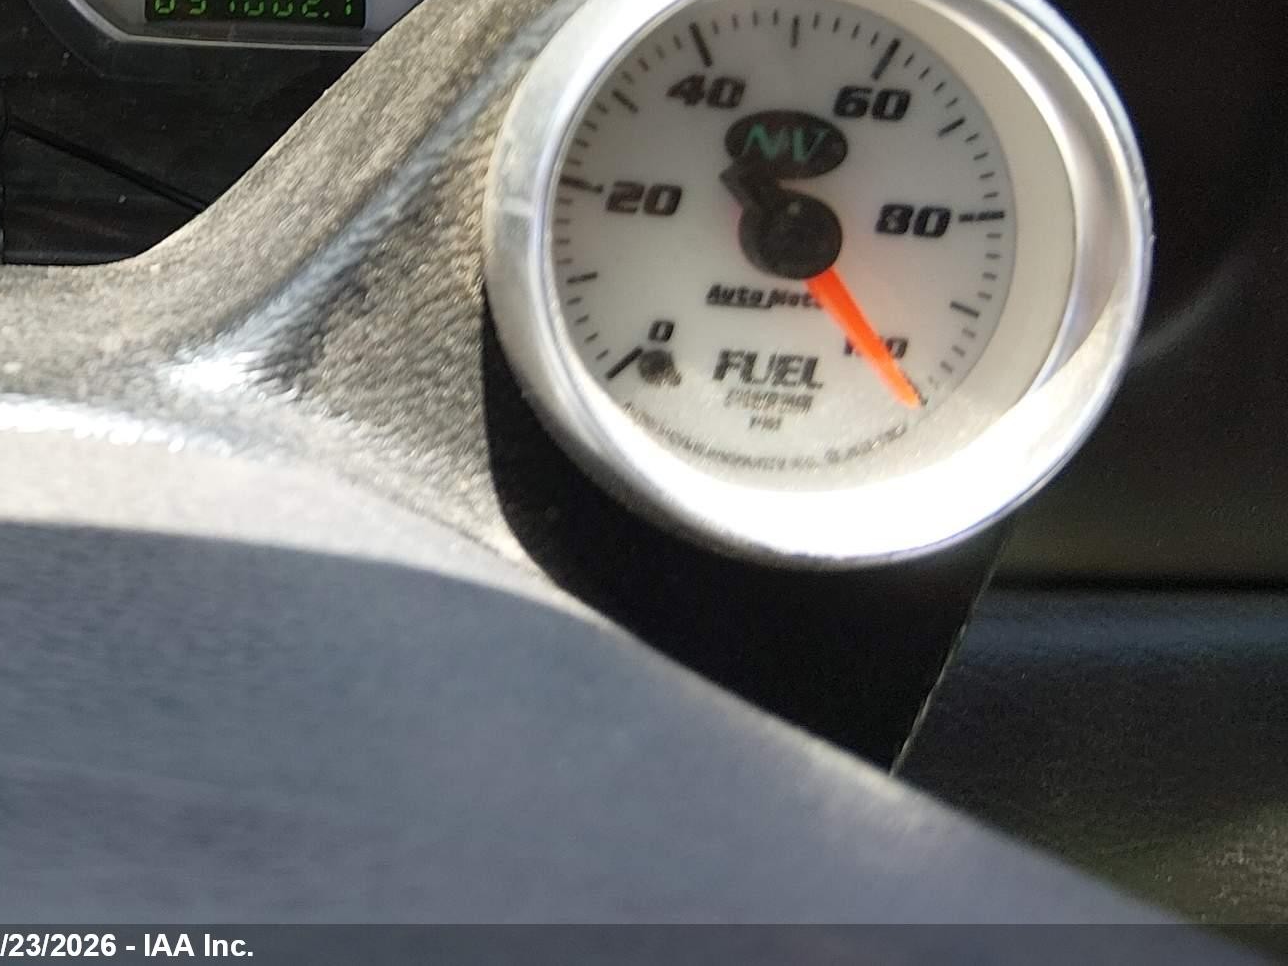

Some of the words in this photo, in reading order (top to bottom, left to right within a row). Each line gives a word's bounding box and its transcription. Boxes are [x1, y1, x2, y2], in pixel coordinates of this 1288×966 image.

[667, 74, 747, 110] 40
[833, 85, 913, 121] 60
[605, 180, 683, 216] 20
[874, 203, 952, 239] 80
[649, 320, 675, 342] 0
[844, 336, 909, 360] 10
[713, 349, 824, 390] FUEL
